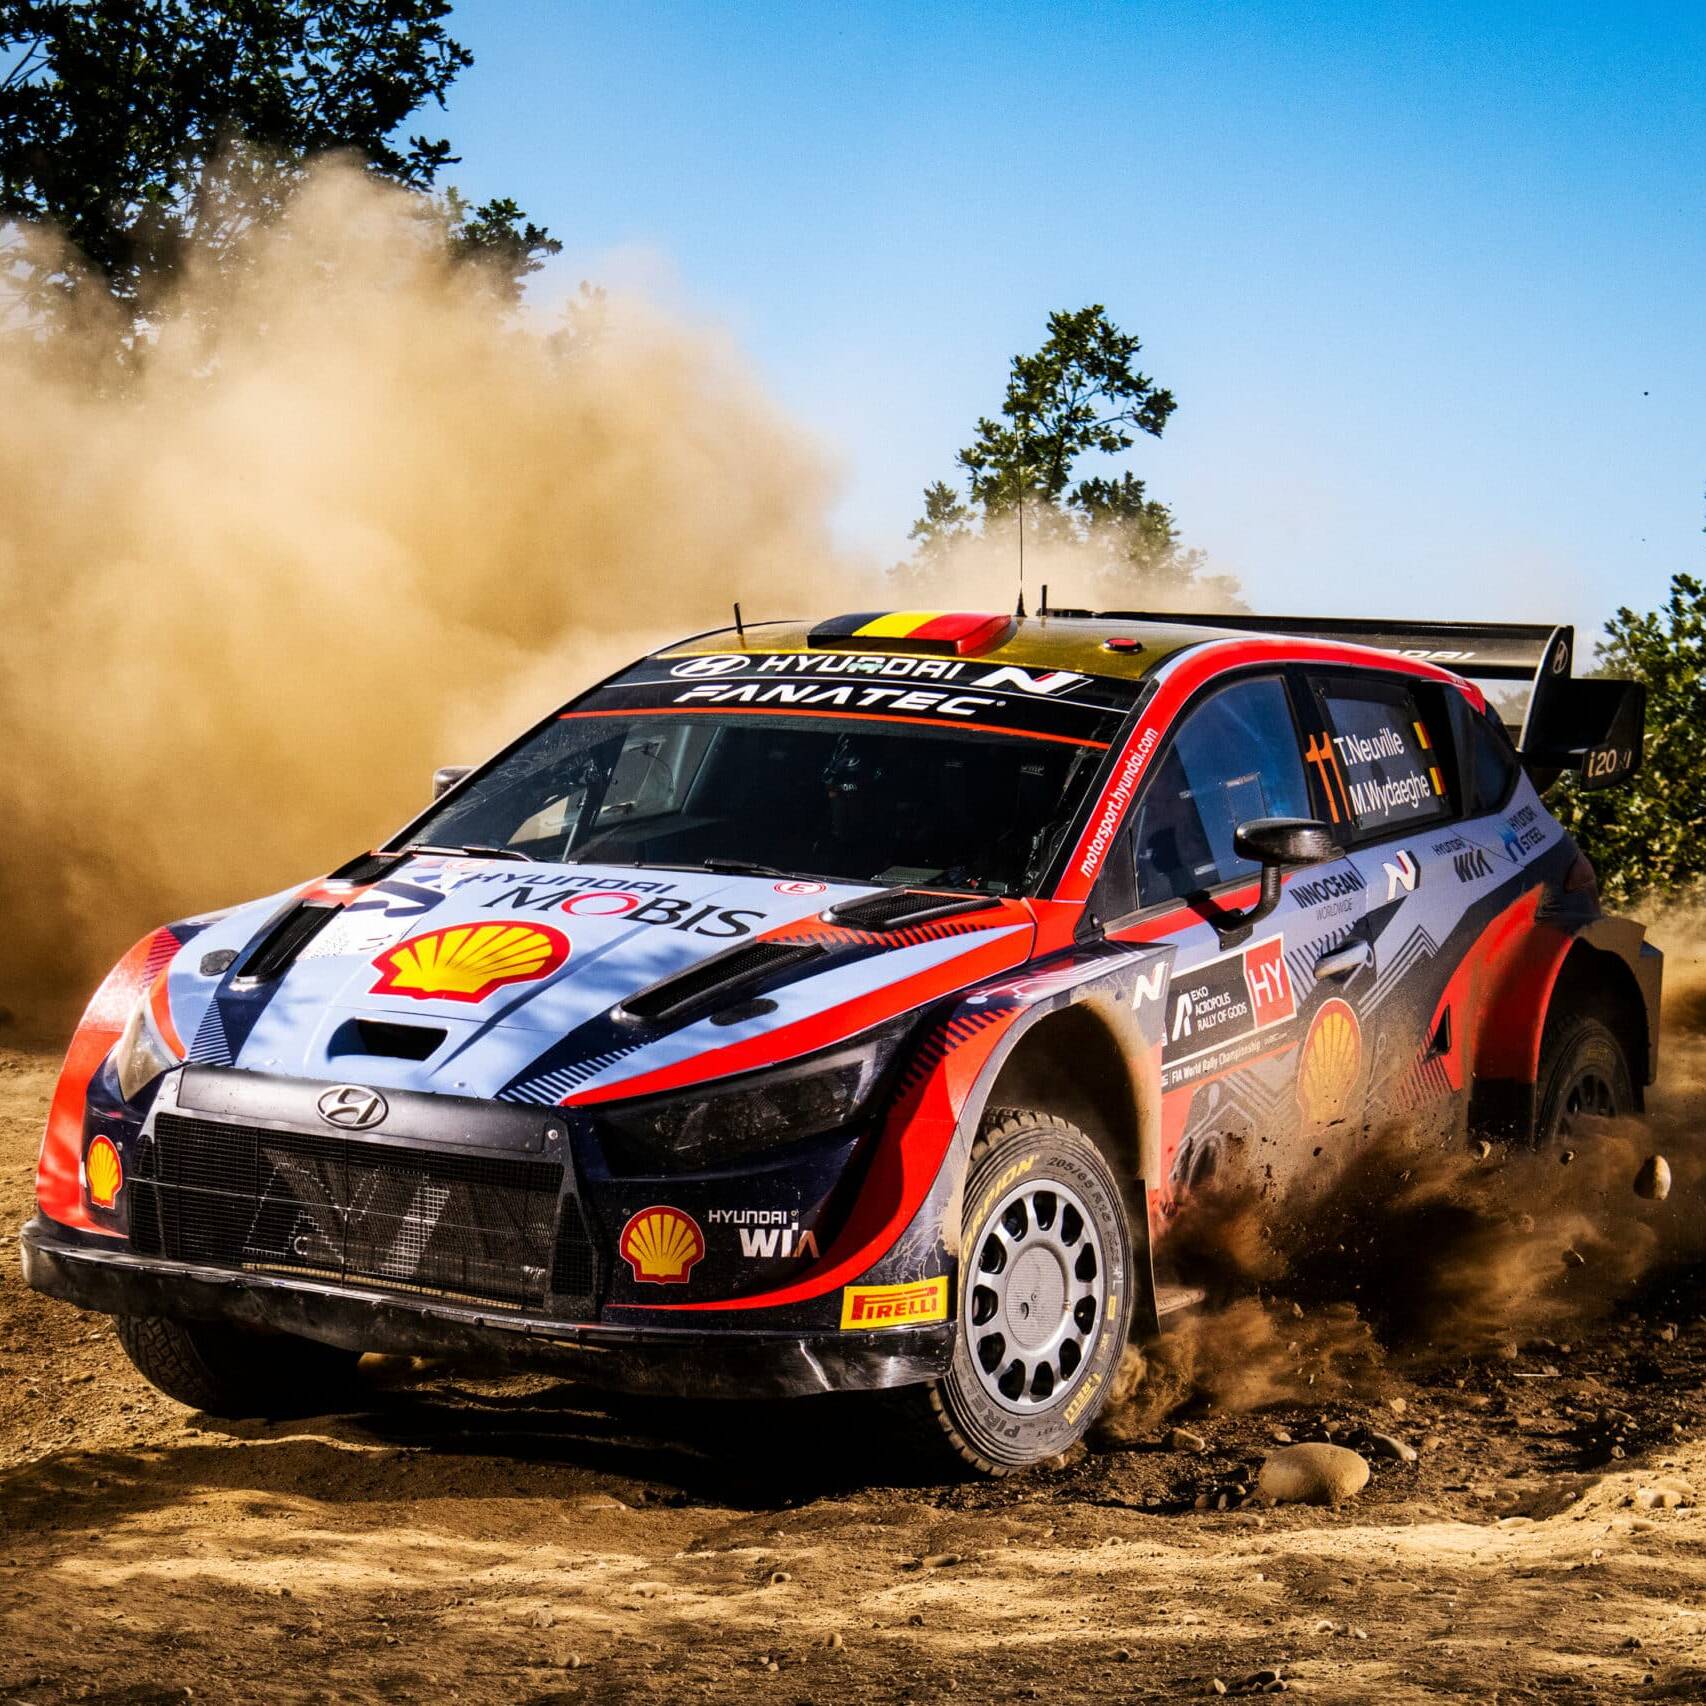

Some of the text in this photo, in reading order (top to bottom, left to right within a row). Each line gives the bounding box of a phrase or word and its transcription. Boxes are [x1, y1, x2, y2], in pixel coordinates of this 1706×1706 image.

[673, 683, 996, 716] FANATEC
[1334, 728, 1404, 766] T.Neuville
[1588, 749, 1617, 778] i20
[1305, 731, 1352, 824] 11
[1349, 771, 1431, 816] M.Wydaeghe
[1080, 727, 1159, 878] motorsport.hyundai.com
[463, 872, 677, 894] HYUNDAI
[1289, 871, 1364, 909] INNOCEAN
[479, 886, 767, 938] MOBIS
[1190, 986, 1209, 1001] EKO
[1249, 959, 1285, 1008] HY
[1195, 992, 1231, 1016] ACROPOLIS
[1197, 1002, 1248, 1031] RALLY OF GODS
[709, 1209, 788, 1225] HYUNDAI
[739, 1222, 820, 1258] WIA
[850, 1286, 938, 1320] PIRELLI
